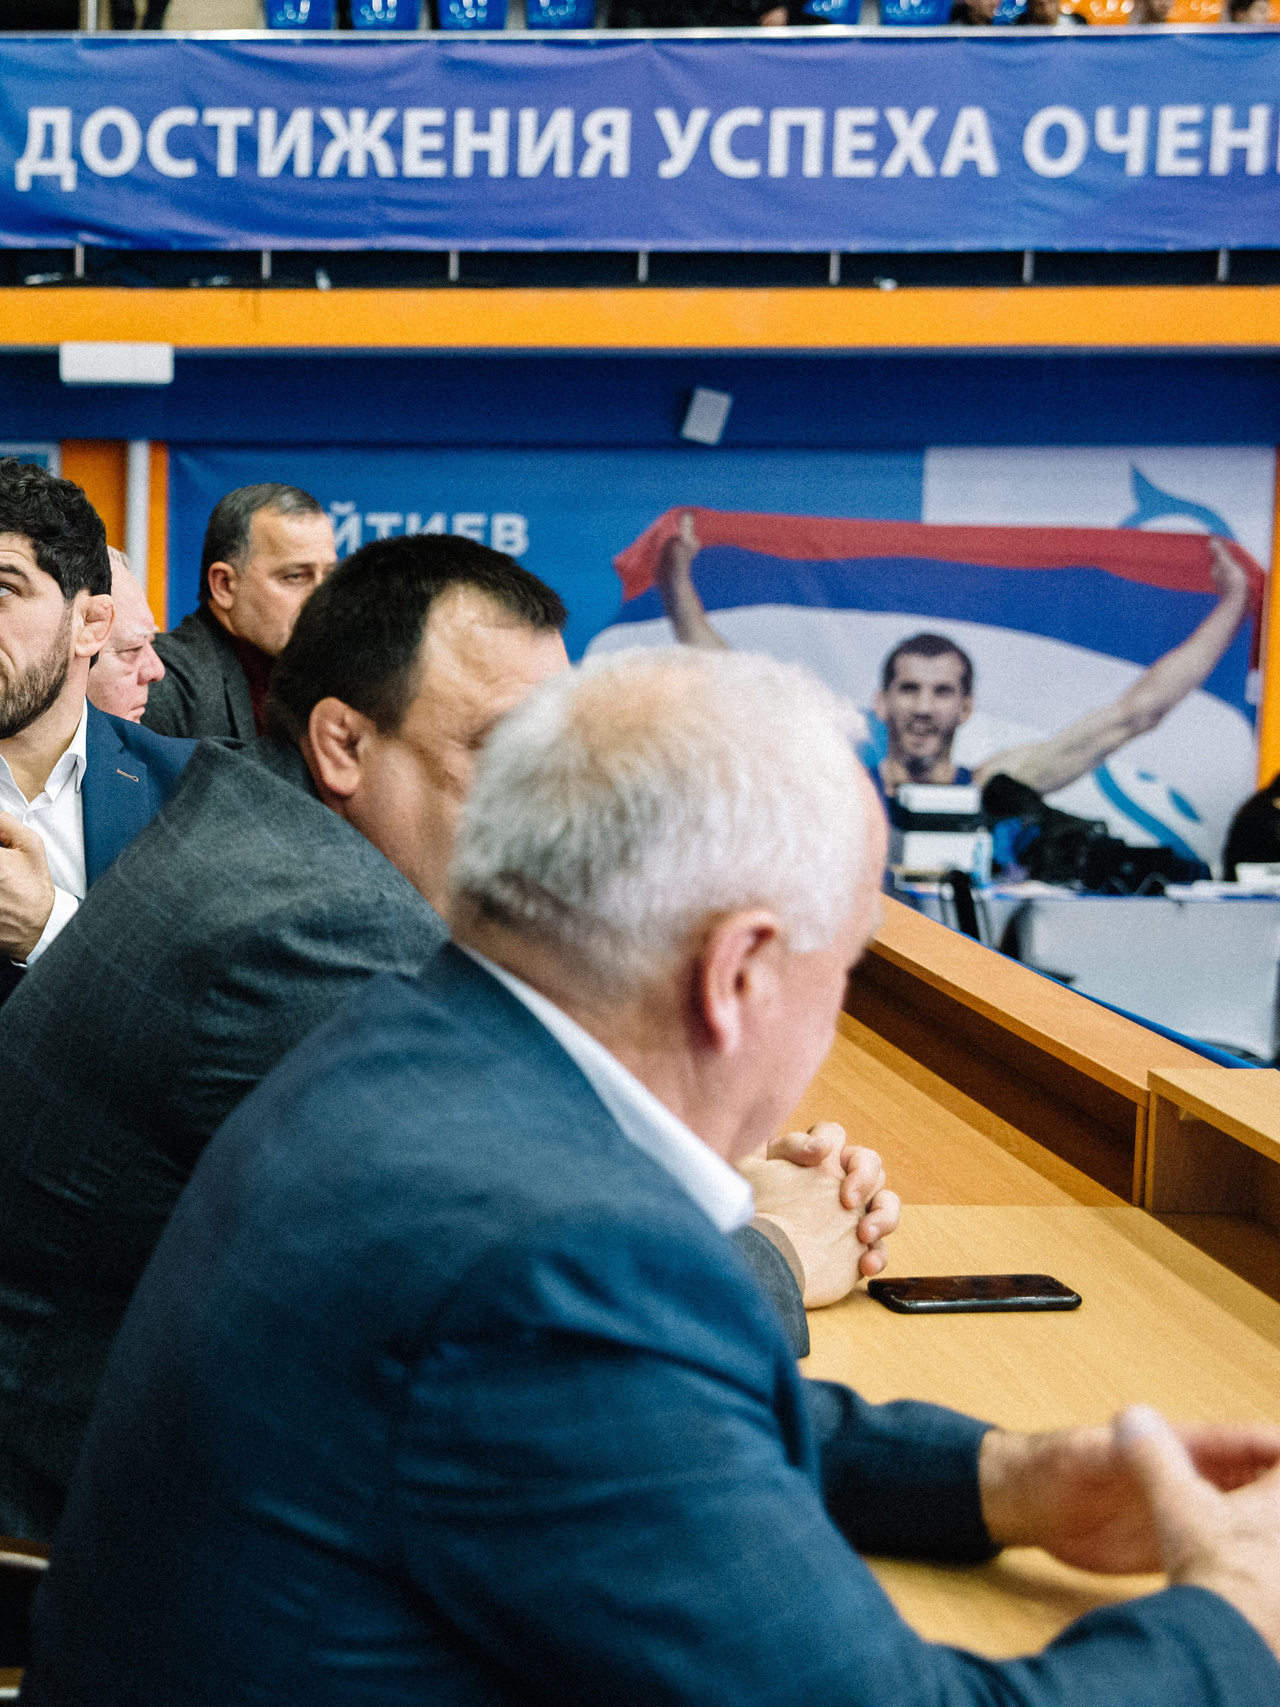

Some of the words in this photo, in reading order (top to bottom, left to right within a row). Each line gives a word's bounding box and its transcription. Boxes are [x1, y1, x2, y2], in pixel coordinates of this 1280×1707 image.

[15, 104, 632, 191] ДОСТИЖЕНИЯ
[654, 105, 1000, 180] УСПЕХА
[1022, 103, 1280, 179] ОЧЕН
